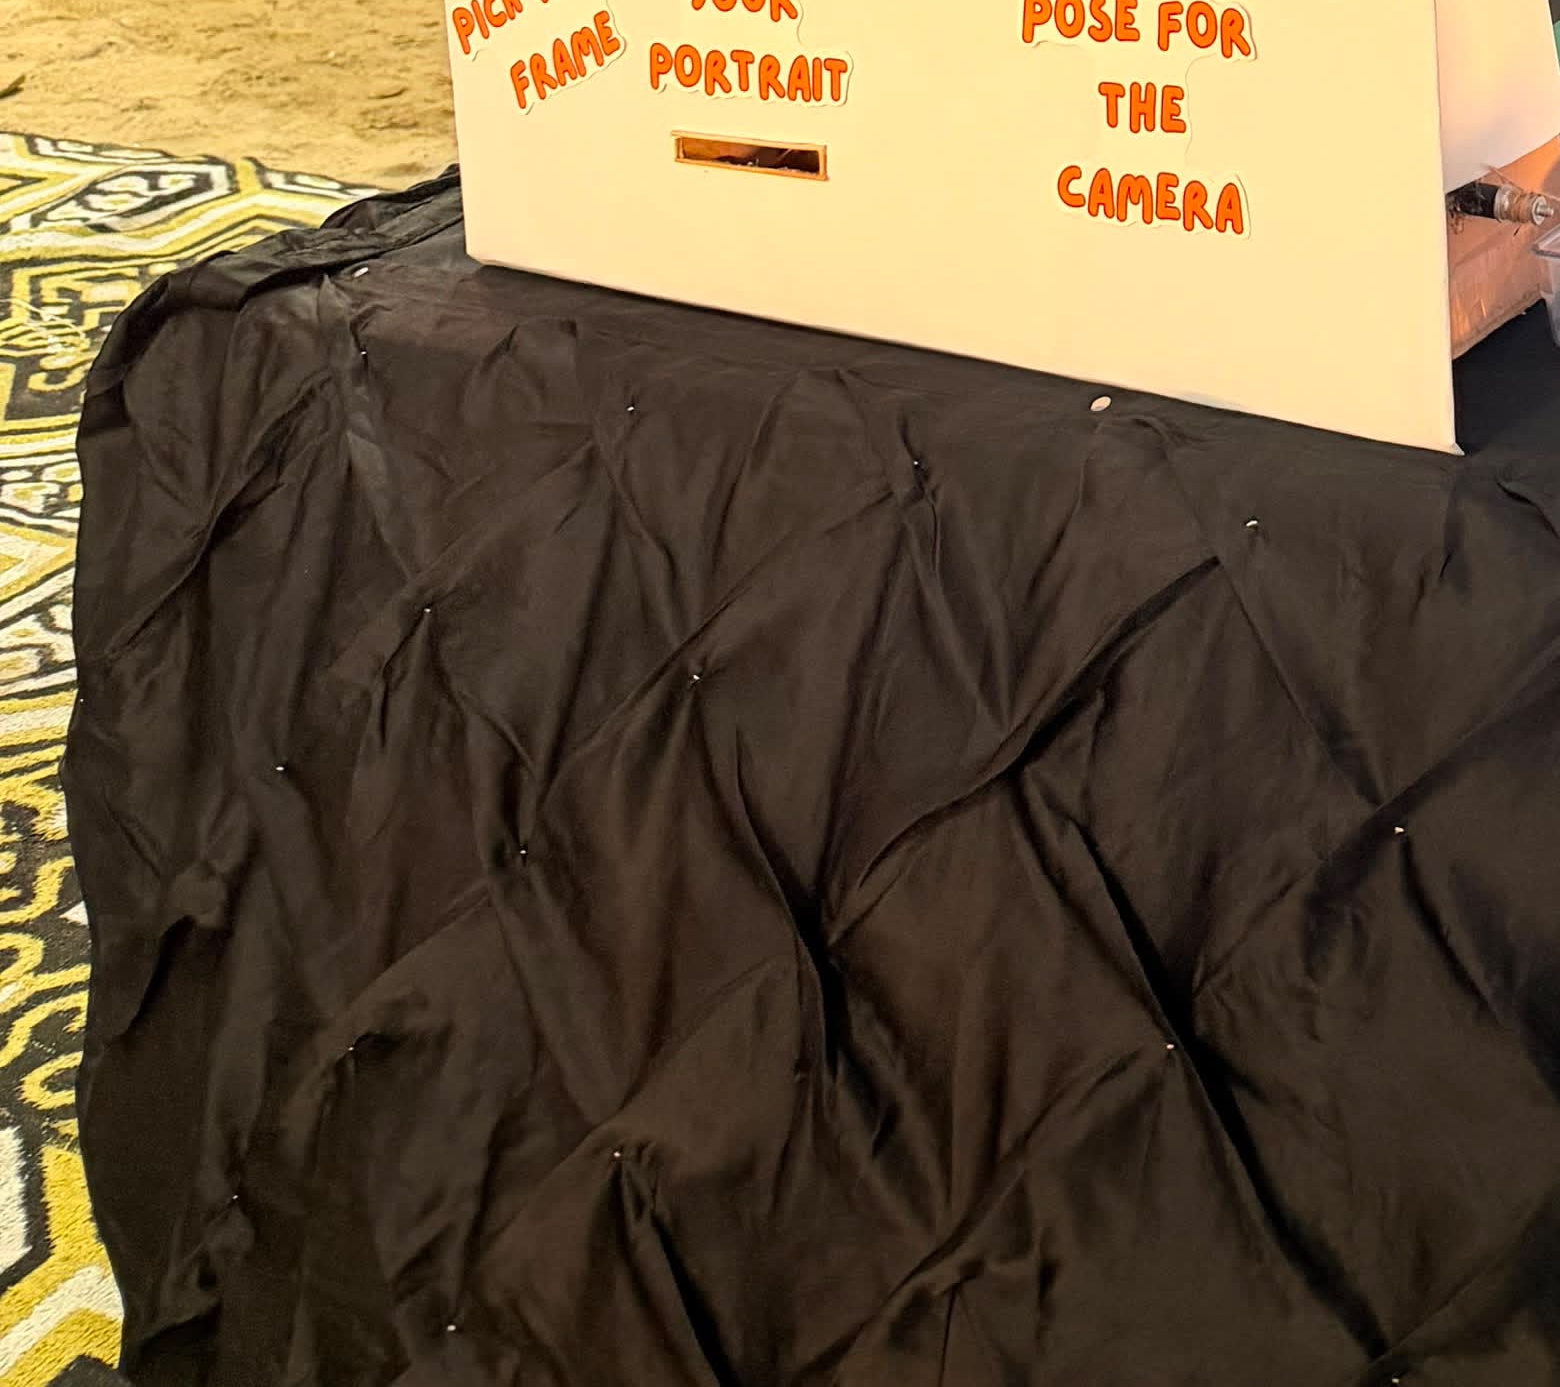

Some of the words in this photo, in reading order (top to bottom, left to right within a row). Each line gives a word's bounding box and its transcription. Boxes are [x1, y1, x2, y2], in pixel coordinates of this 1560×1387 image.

[510, 10, 621, 109] FRAME
[1157, 0, 1251, 59] FOR
[649, 42, 849, 105] PORTRAIT
[1098, 82, 1187, 134] THE
[1057, 165, 1244, 235] CAMERA
